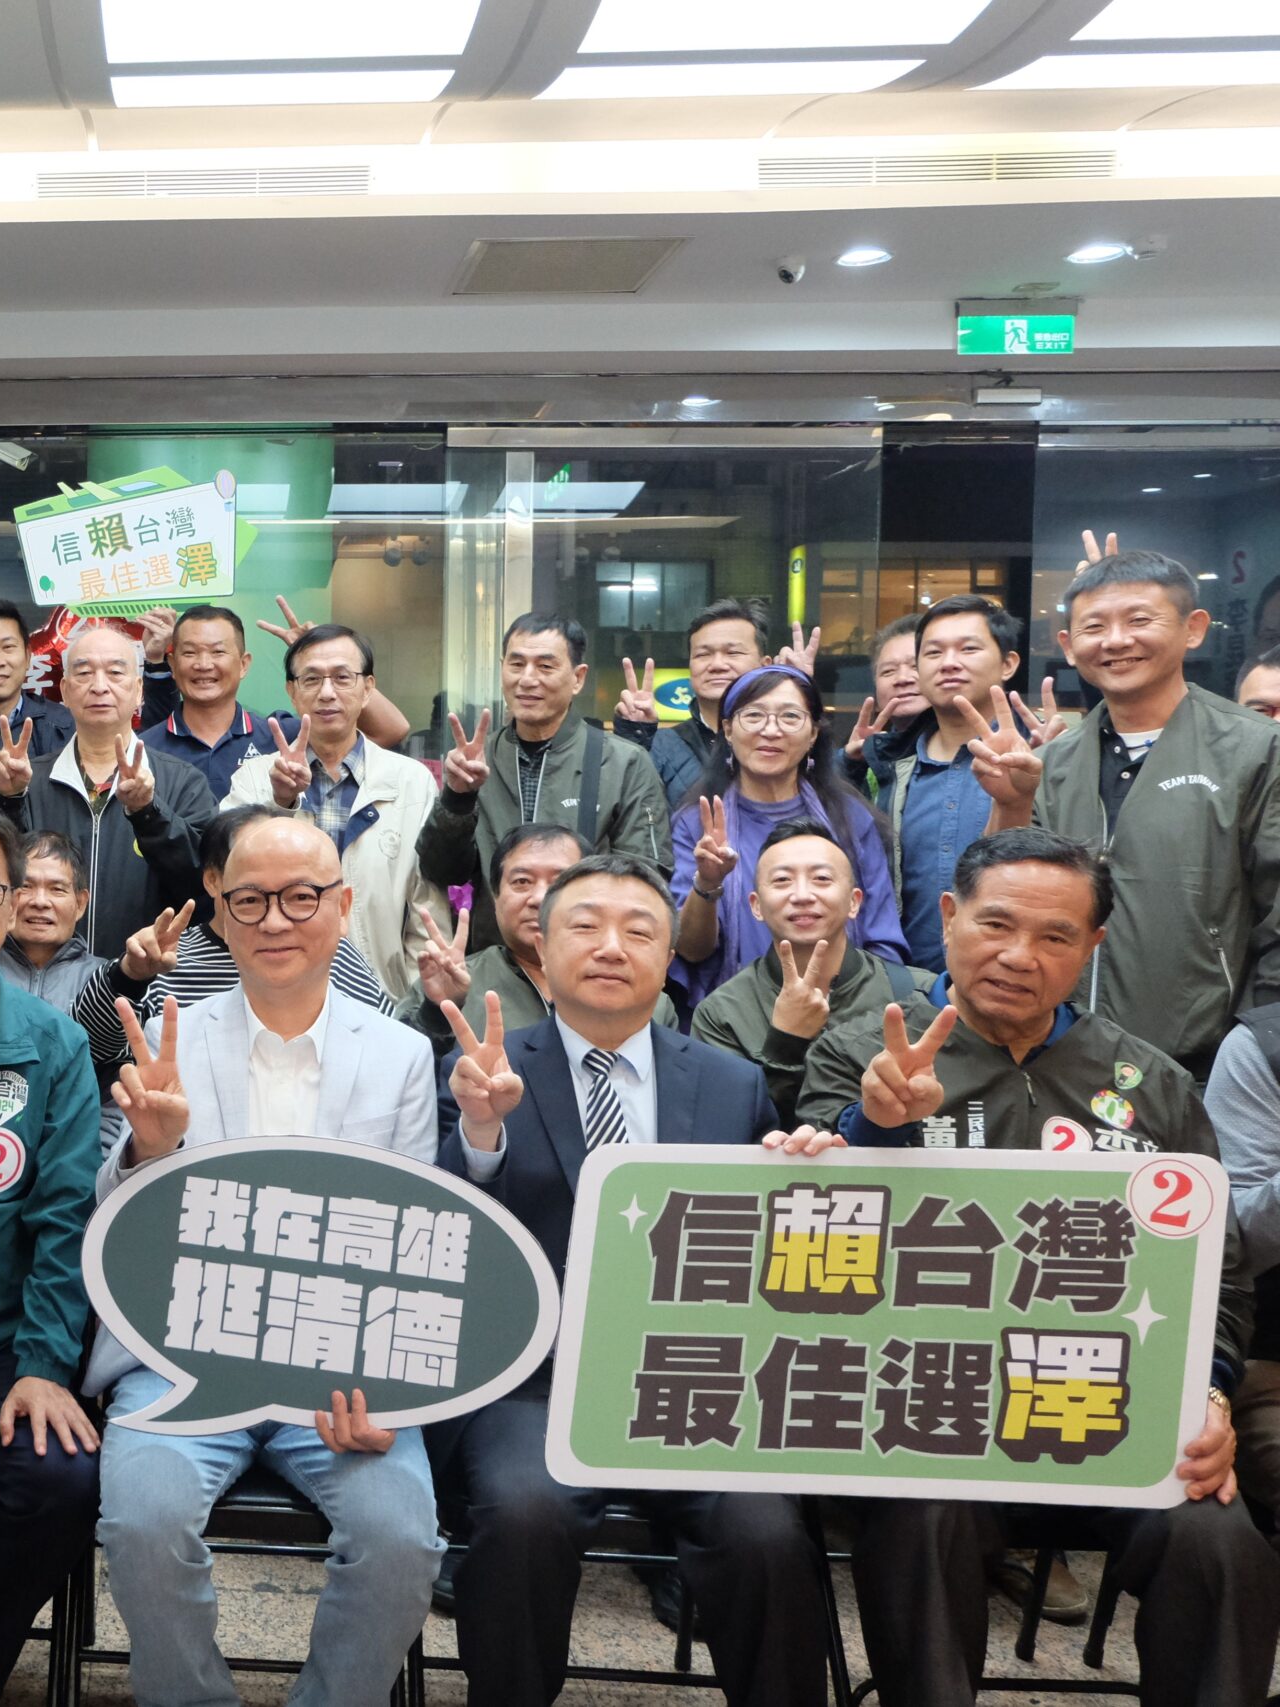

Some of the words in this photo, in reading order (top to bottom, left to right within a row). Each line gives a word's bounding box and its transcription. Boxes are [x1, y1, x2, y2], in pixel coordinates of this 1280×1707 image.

[1035, 342, 1068, 350] EXIT
[51, 506, 197, 566] 信賴台灣
[78, 542, 218, 600] 最佳選澤
[1157, 775, 1187, 792] TEAM
[1187, 774, 1221, 793] TAIWAN
[178, 1175, 472, 1283] 我在高雄
[1149, 1168, 1195, 1229] 2
[648, 1185, 1140, 1313] 信賴台灣
[164, 1256, 464, 1388] 挺清德
[628, 1330, 1132, 1463] 最佳選澤
